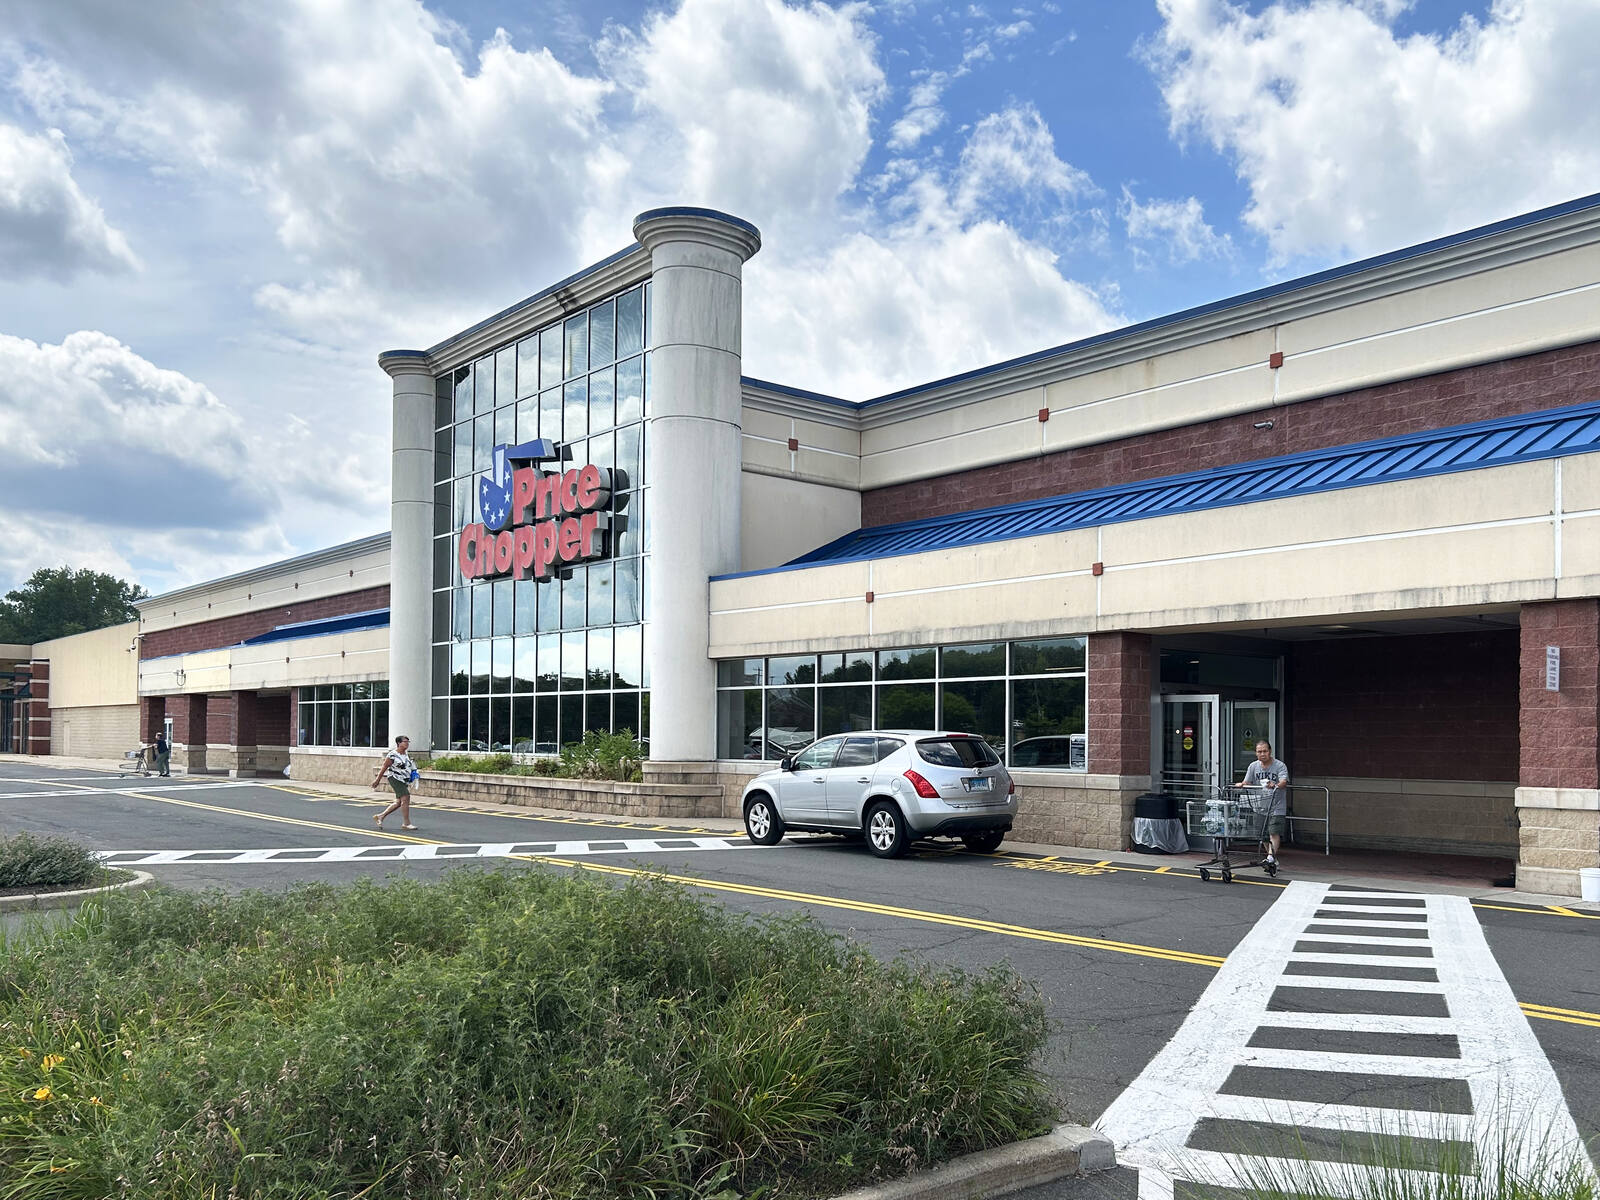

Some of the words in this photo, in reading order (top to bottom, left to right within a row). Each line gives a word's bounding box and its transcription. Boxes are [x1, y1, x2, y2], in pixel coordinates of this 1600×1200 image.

[513, 464, 602, 525] Price
[459, 512, 600, 580] Chopper
[1256, 772, 1278, 782] NIKE
